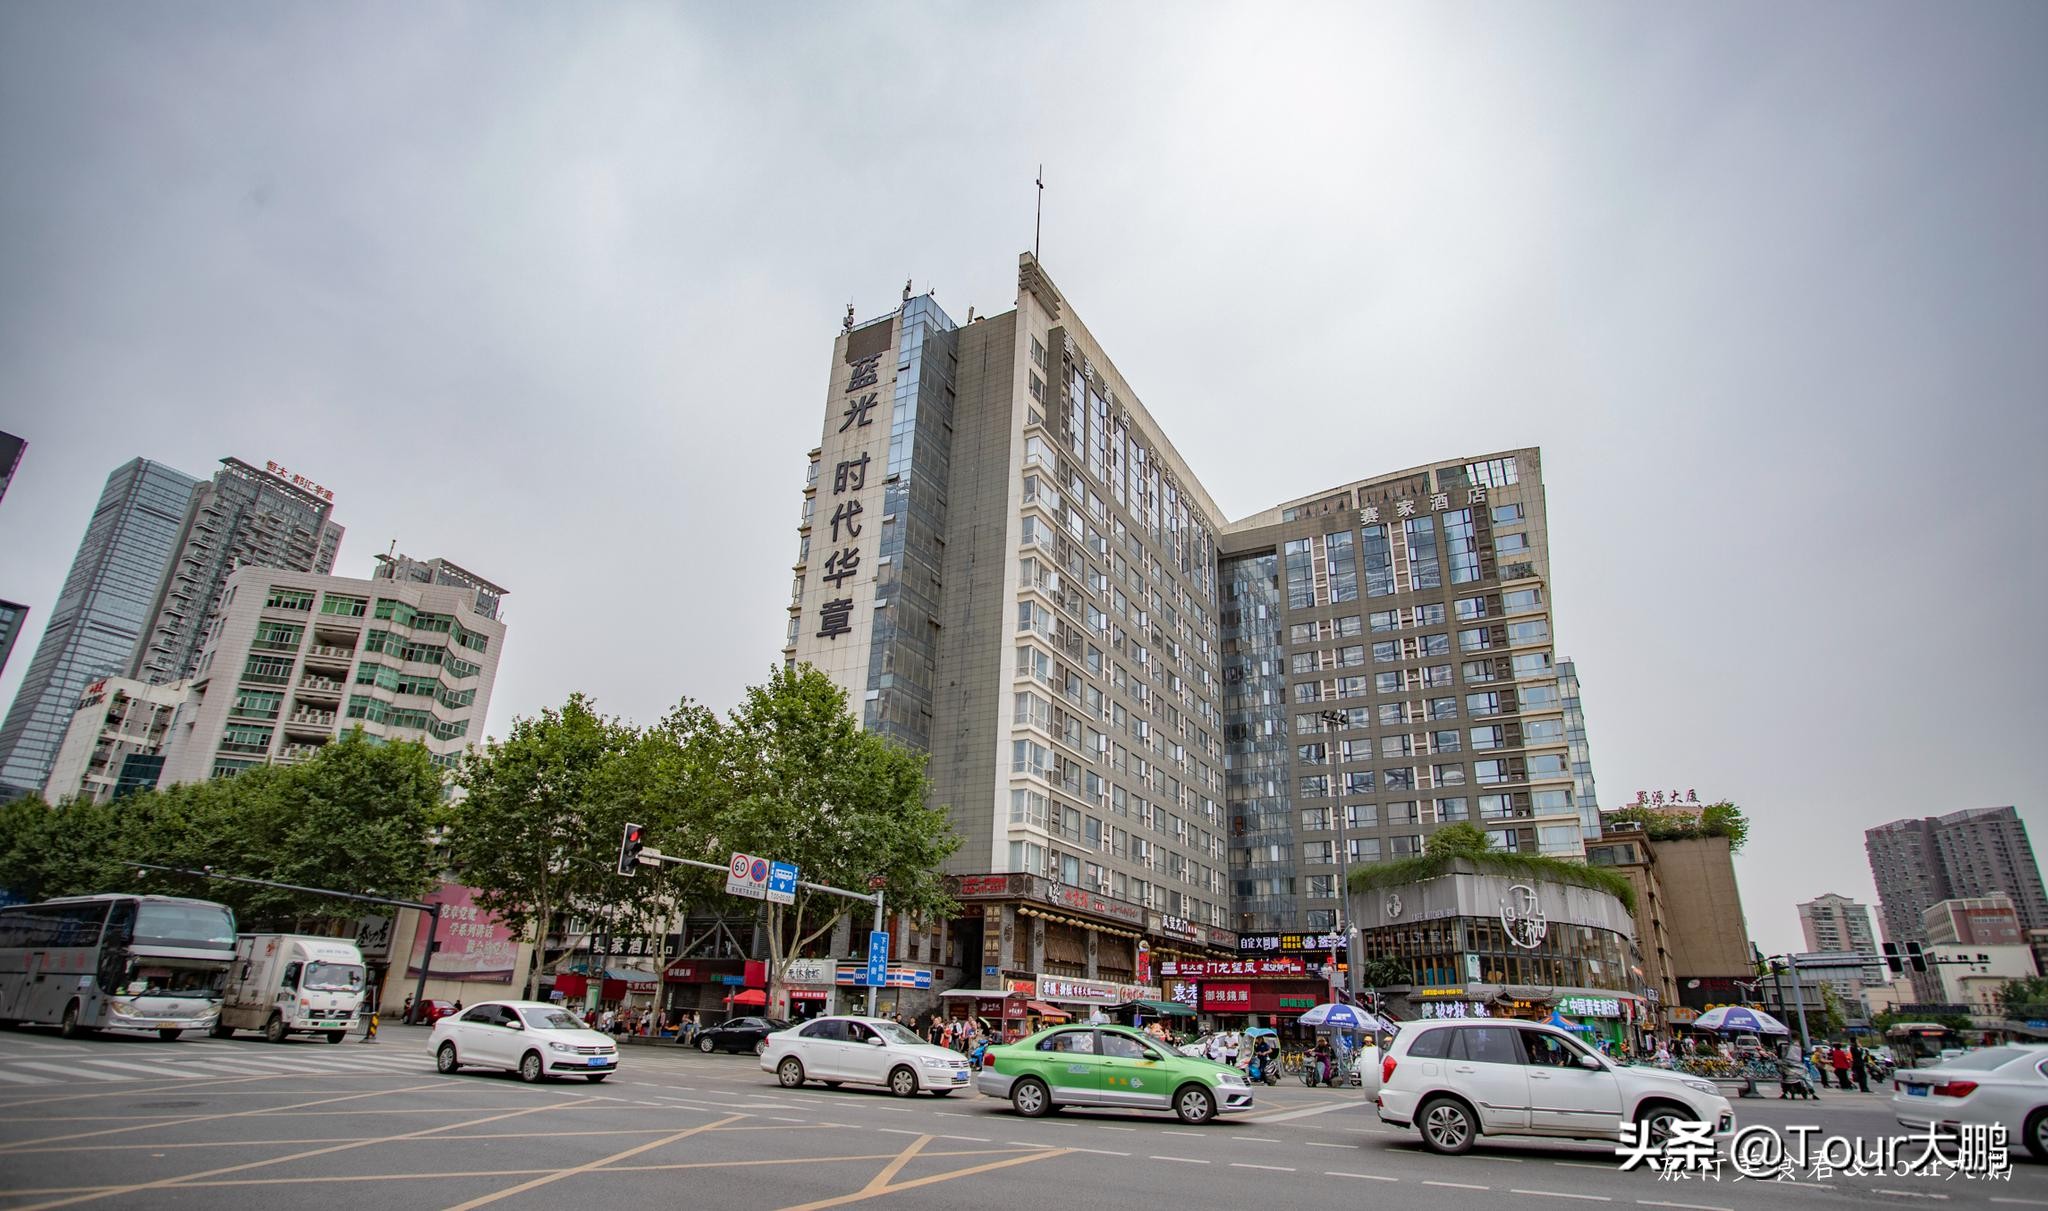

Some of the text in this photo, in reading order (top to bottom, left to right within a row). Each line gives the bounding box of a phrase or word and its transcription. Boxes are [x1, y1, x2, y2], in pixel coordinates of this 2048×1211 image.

[816, 352, 882, 640] 蓝光时代华章
[1360, 485, 1487, 525] 赛家酒店
[734, 861, 746, 872] 60
